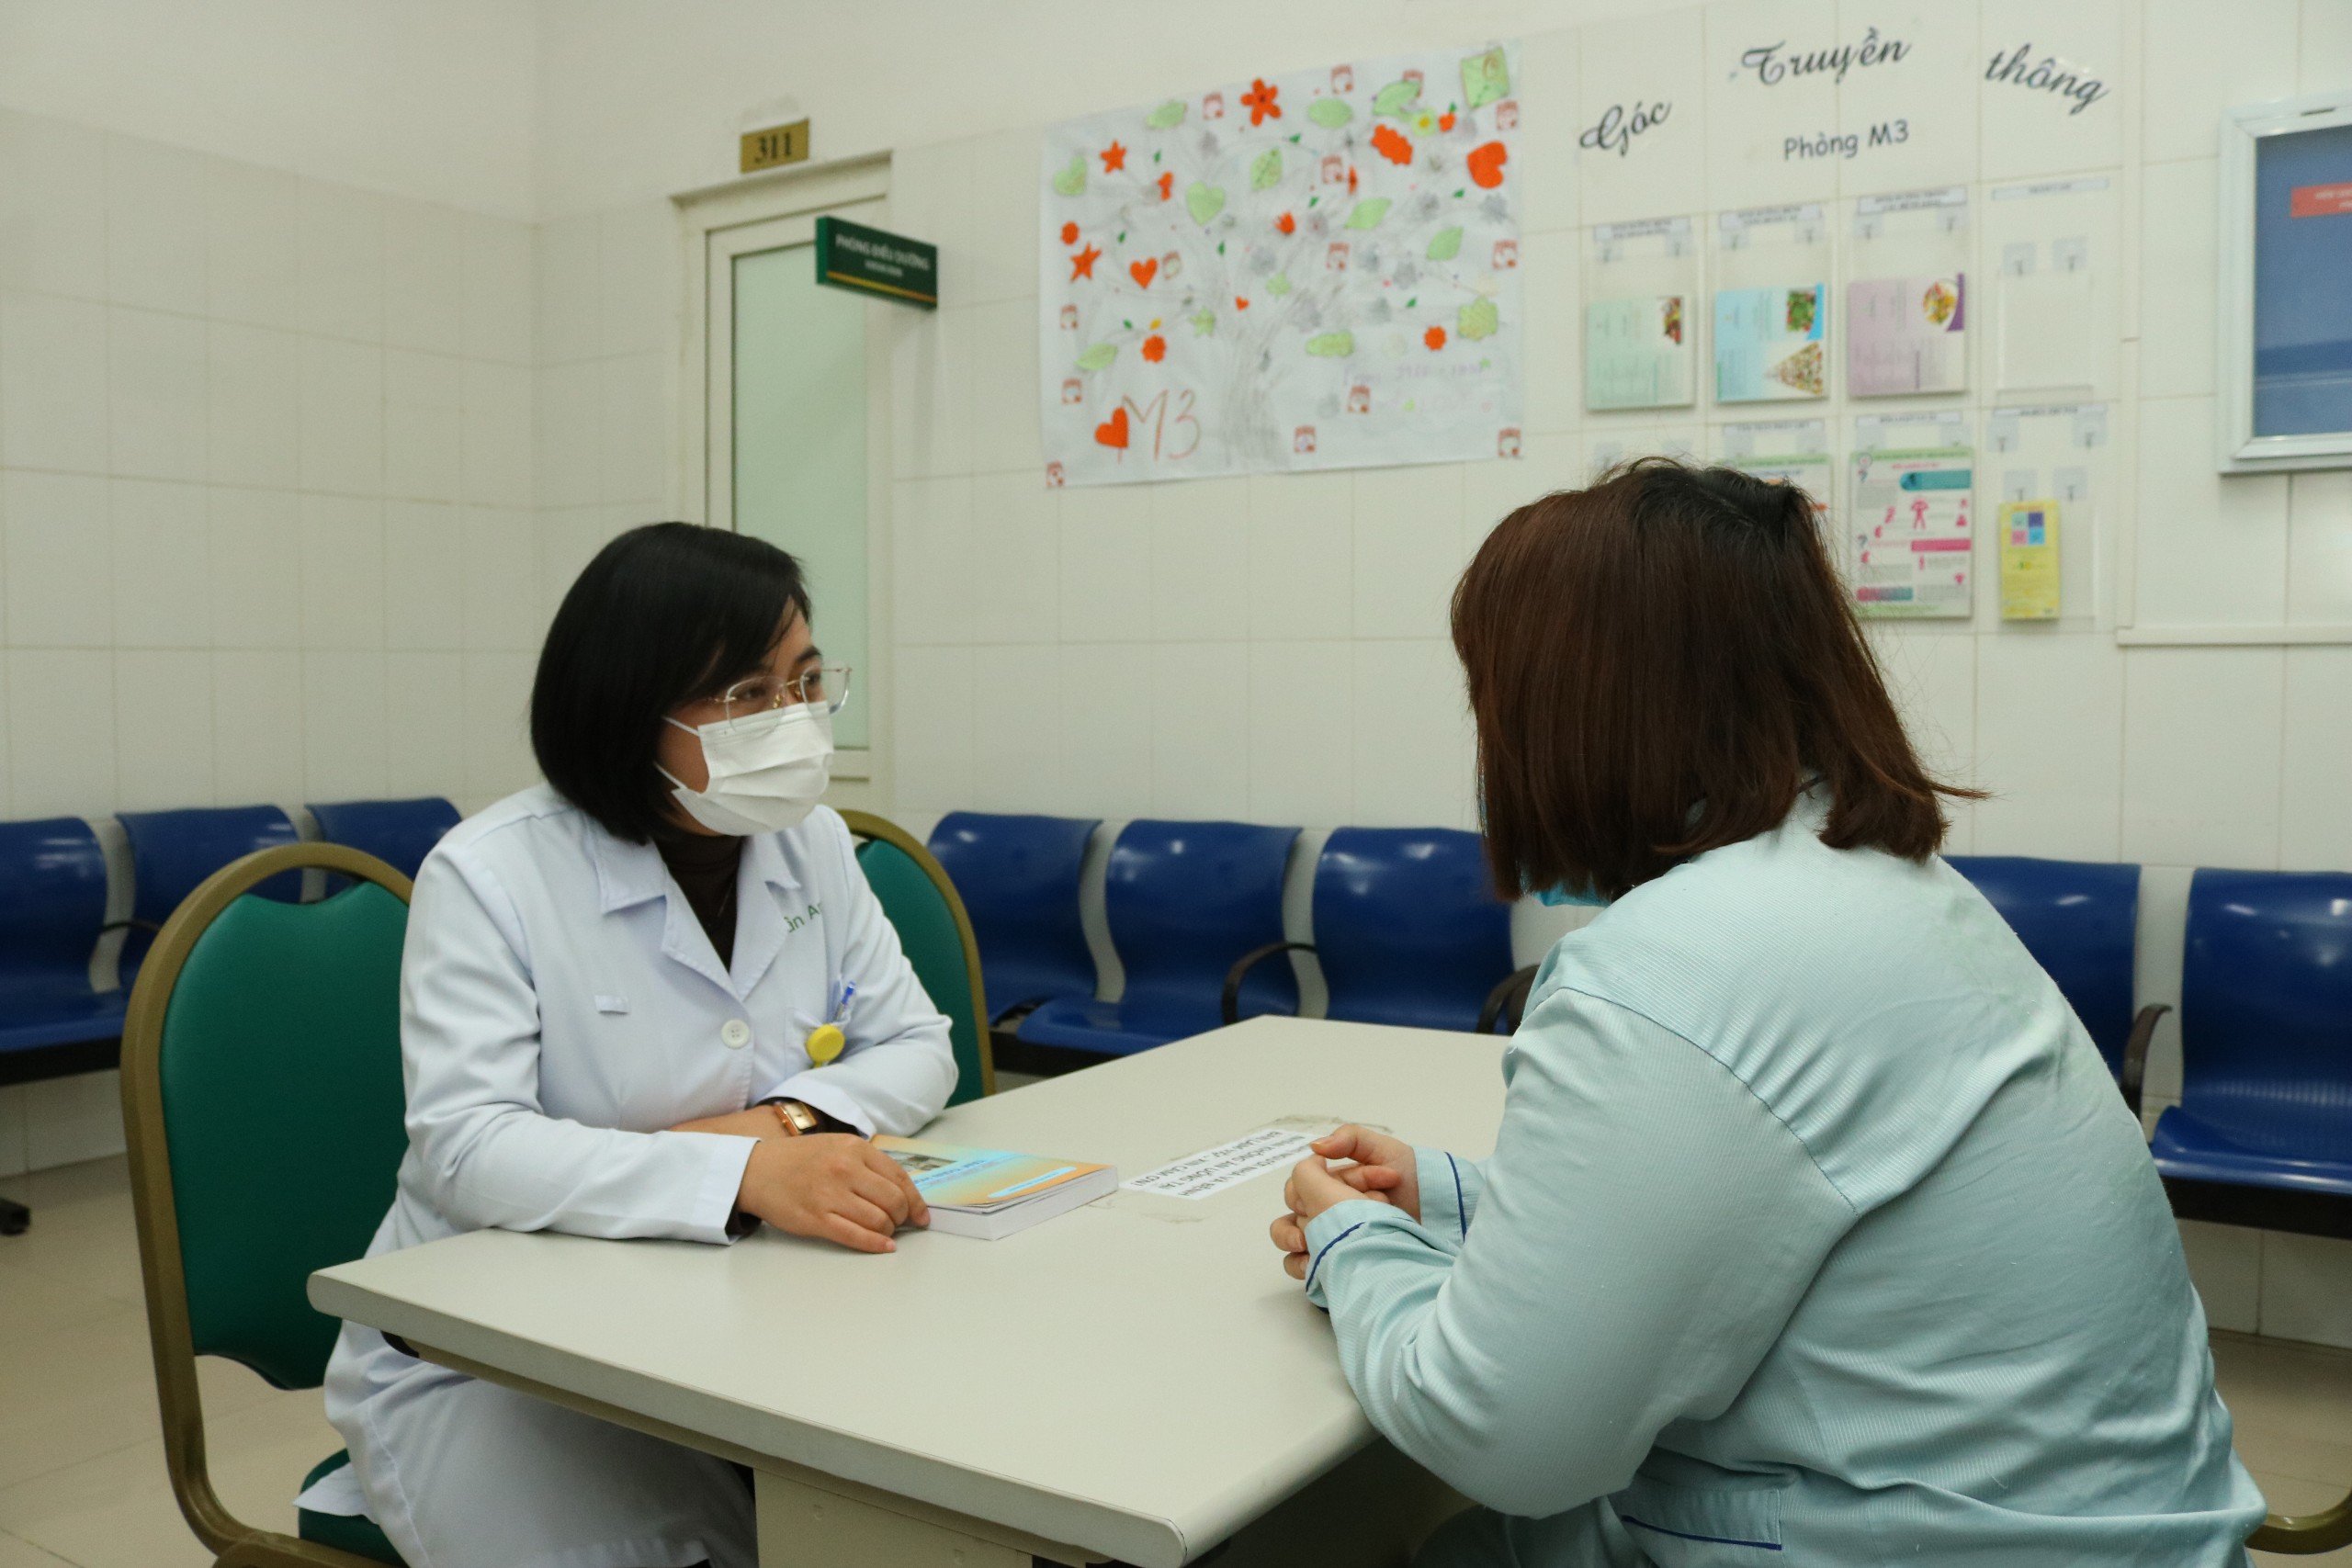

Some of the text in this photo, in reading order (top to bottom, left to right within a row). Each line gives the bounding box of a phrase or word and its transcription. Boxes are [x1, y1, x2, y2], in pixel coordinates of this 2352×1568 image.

[1579, 26, 2110, 157] Góc Truyền thông
[754, 132, 792, 164] 311
[1784, 118, 1909, 161] Phòng M3
